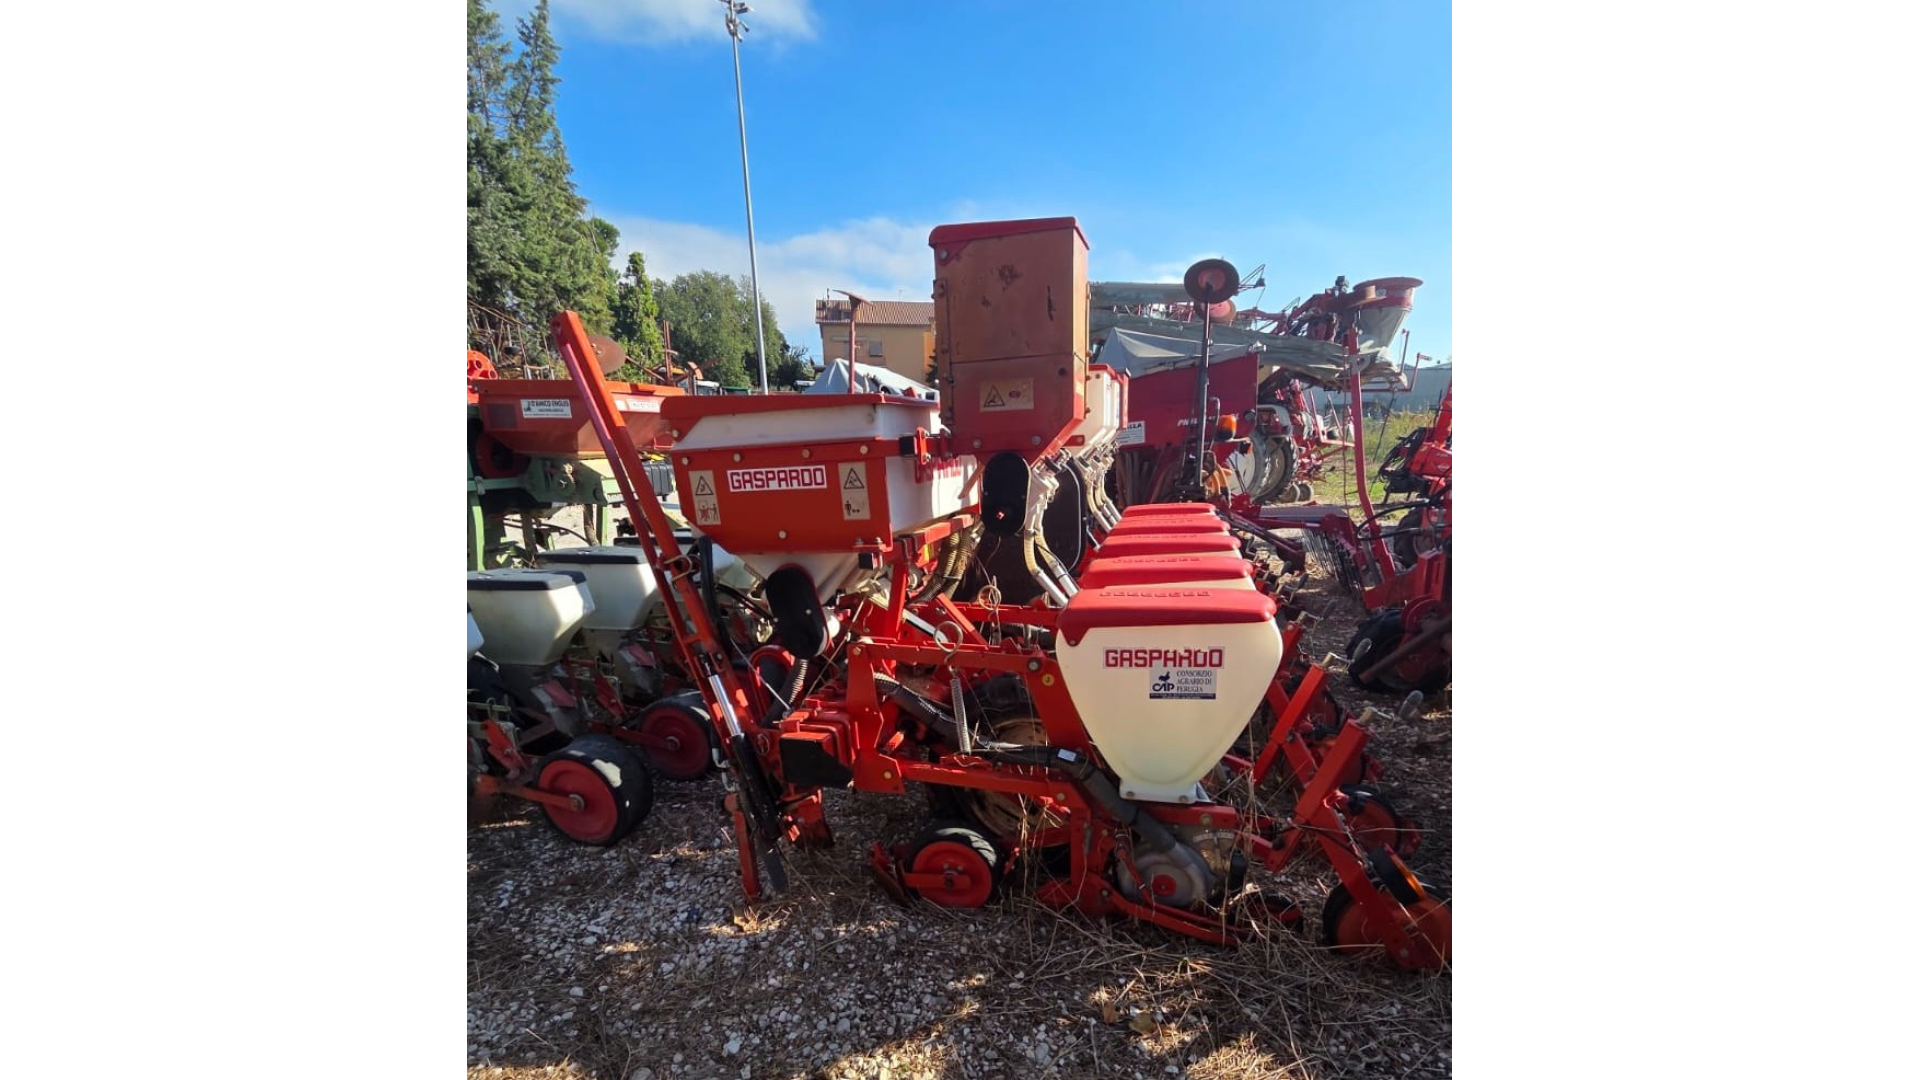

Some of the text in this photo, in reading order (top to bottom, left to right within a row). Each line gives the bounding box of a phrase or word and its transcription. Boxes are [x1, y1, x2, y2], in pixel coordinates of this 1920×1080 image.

[730, 468, 825, 490] GASPARDO
[1105, 648, 1223, 668] GASPARDO
[1176, 669, 1212, 677] CONSORZIO
[1176, 677, 1212, 685] AGRARIO DI
[1152, 682, 1175, 692] CAP
[1176, 685, 1203, 693] PERUGIA
